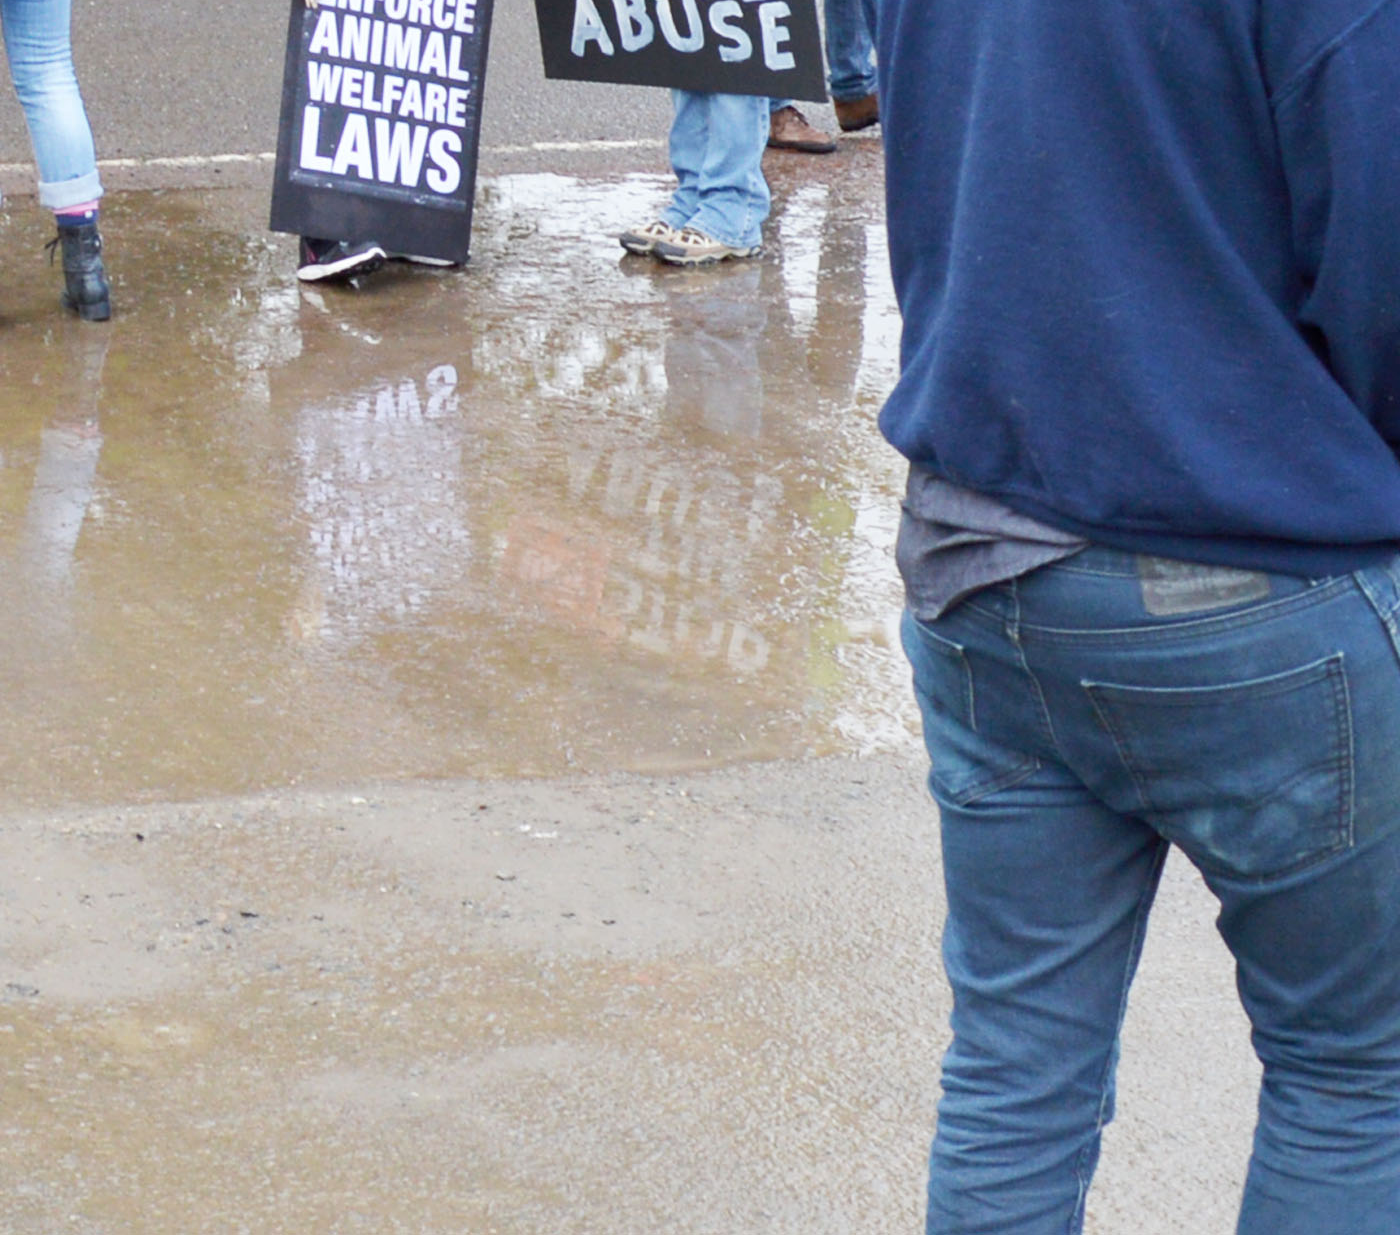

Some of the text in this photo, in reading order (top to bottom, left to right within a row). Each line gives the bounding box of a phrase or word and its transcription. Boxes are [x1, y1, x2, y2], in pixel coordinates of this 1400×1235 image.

[308, 10, 470, 82] ANIMAL
[307, 60, 470, 128] WELFARE
[300, 105, 463, 195] LAWS
